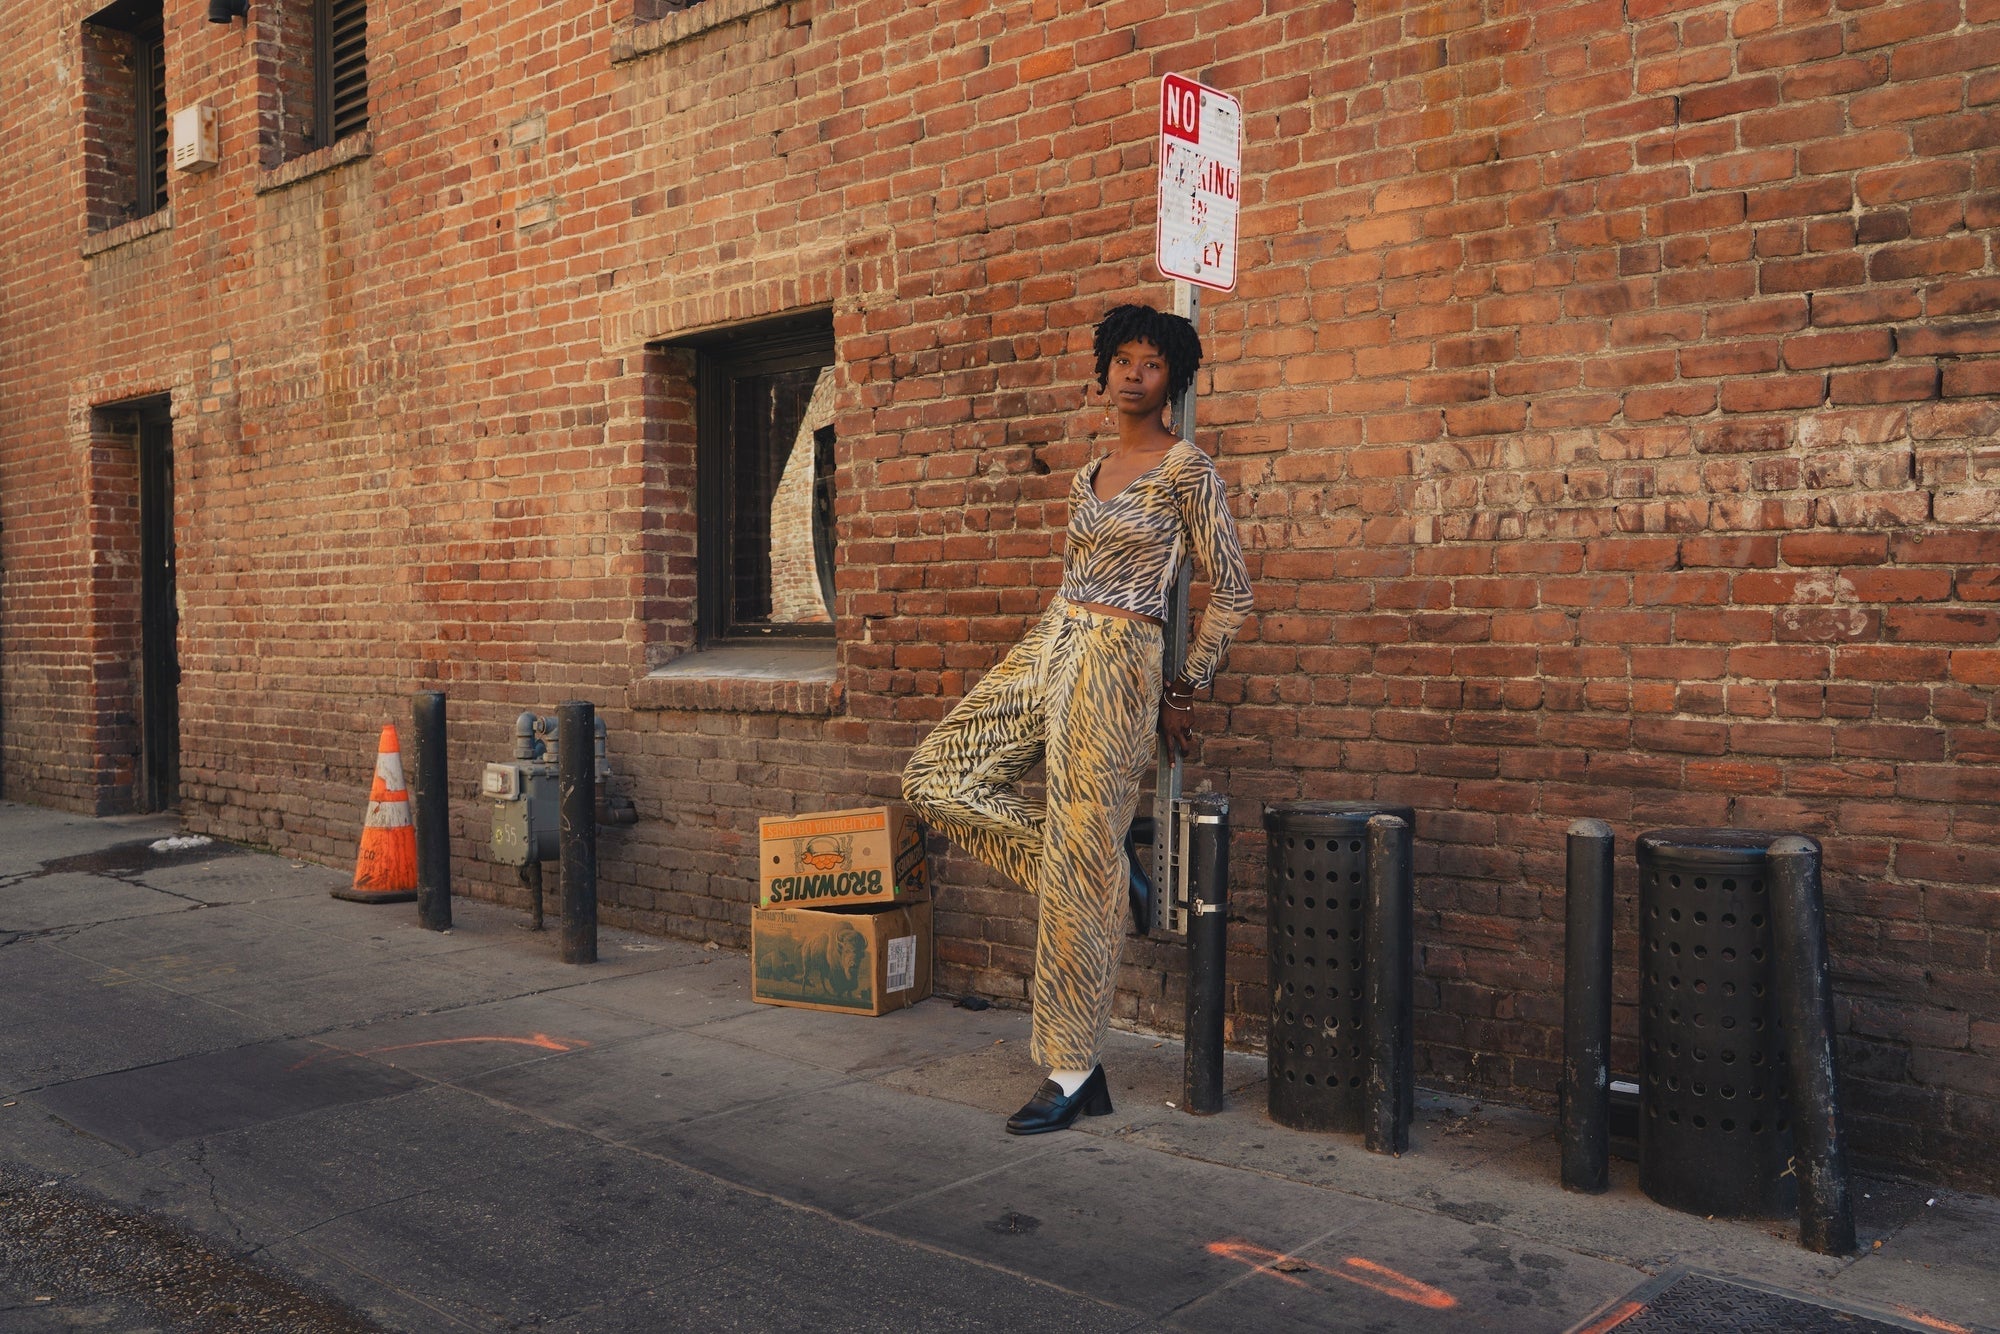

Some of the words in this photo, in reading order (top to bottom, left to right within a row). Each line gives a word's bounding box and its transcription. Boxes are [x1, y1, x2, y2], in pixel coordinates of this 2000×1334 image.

[1167, 83, 1196, 133] NO
[768, 821, 812, 837] ORANGES
[814, 816, 878, 831] CALIFORNIA
[770, 869, 883, 903] BROWNIES
